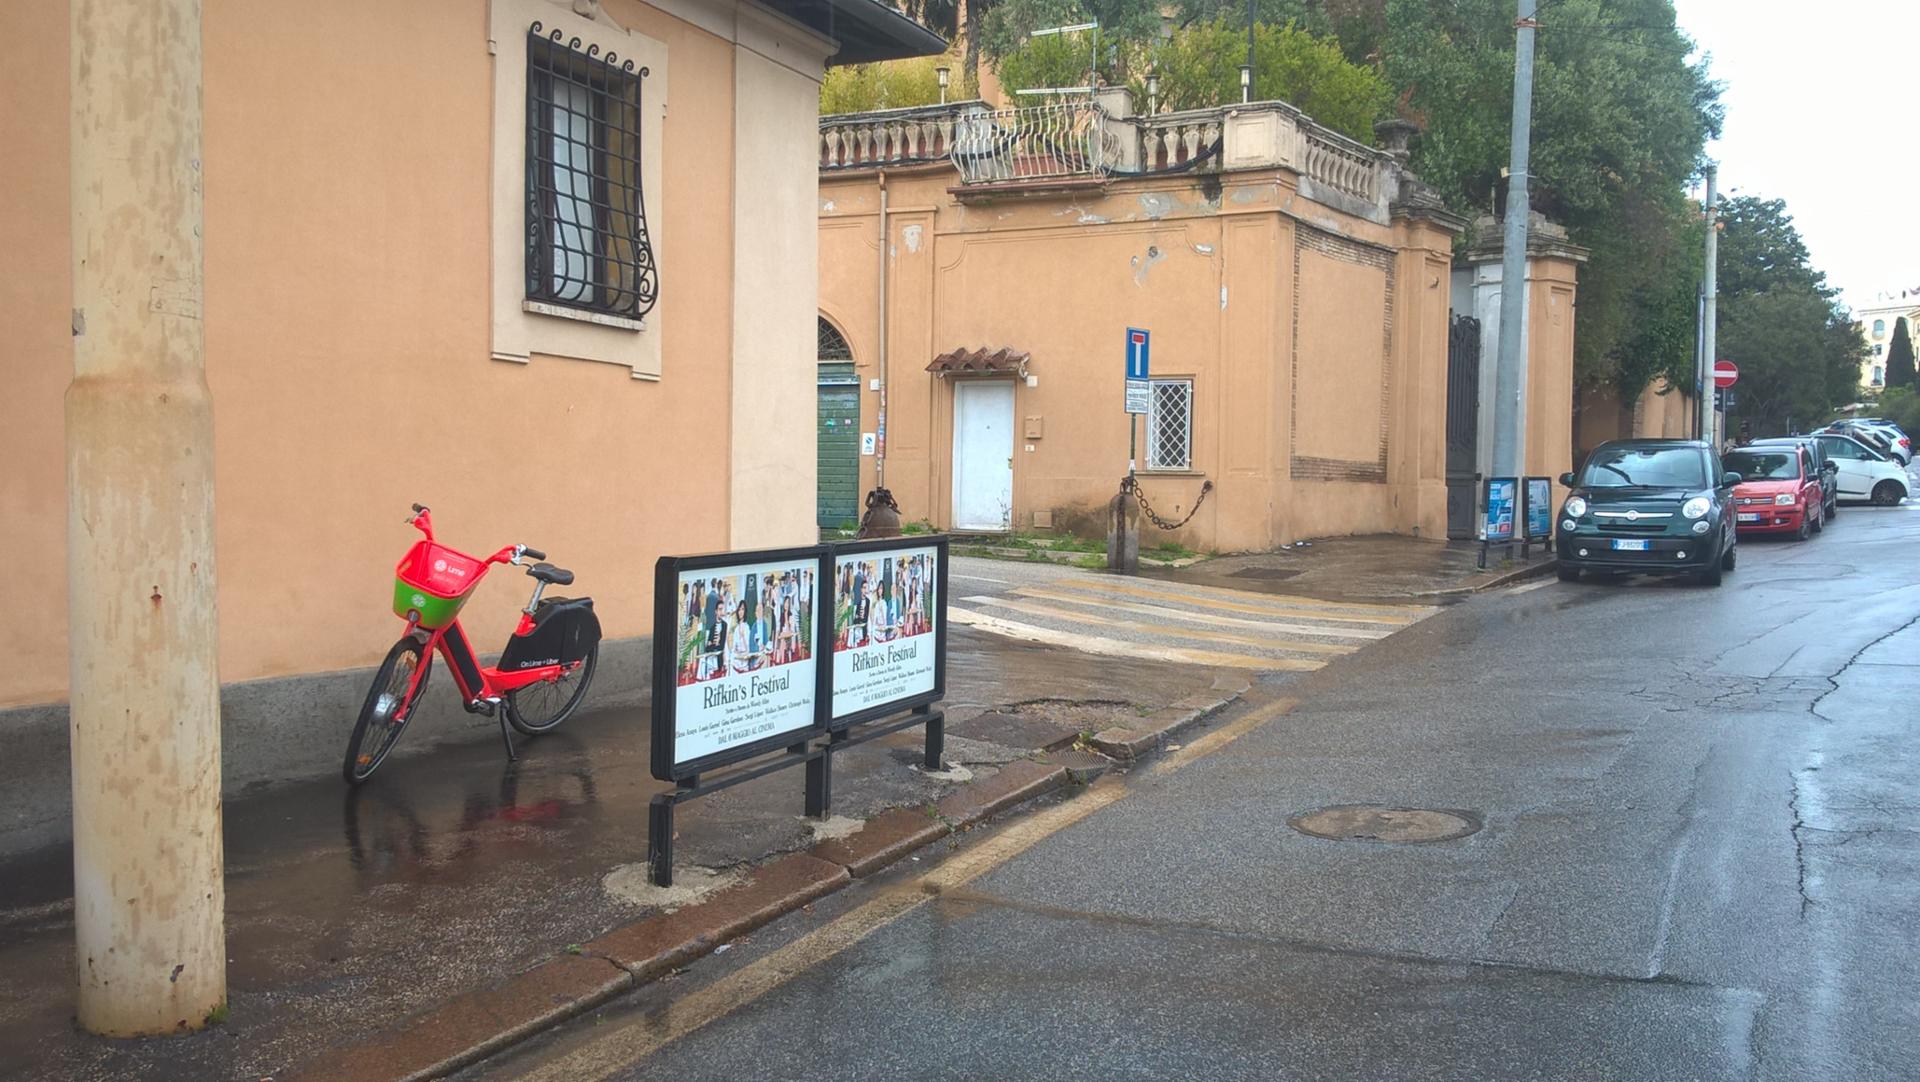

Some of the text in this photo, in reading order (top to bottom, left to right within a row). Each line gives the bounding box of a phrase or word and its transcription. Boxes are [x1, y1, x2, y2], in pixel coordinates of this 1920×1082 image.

[851, 650, 886, 673] Rifkin's
[886, 640, 917, 664] Festival
[703, 669, 790, 710] Rifkin's Festival
